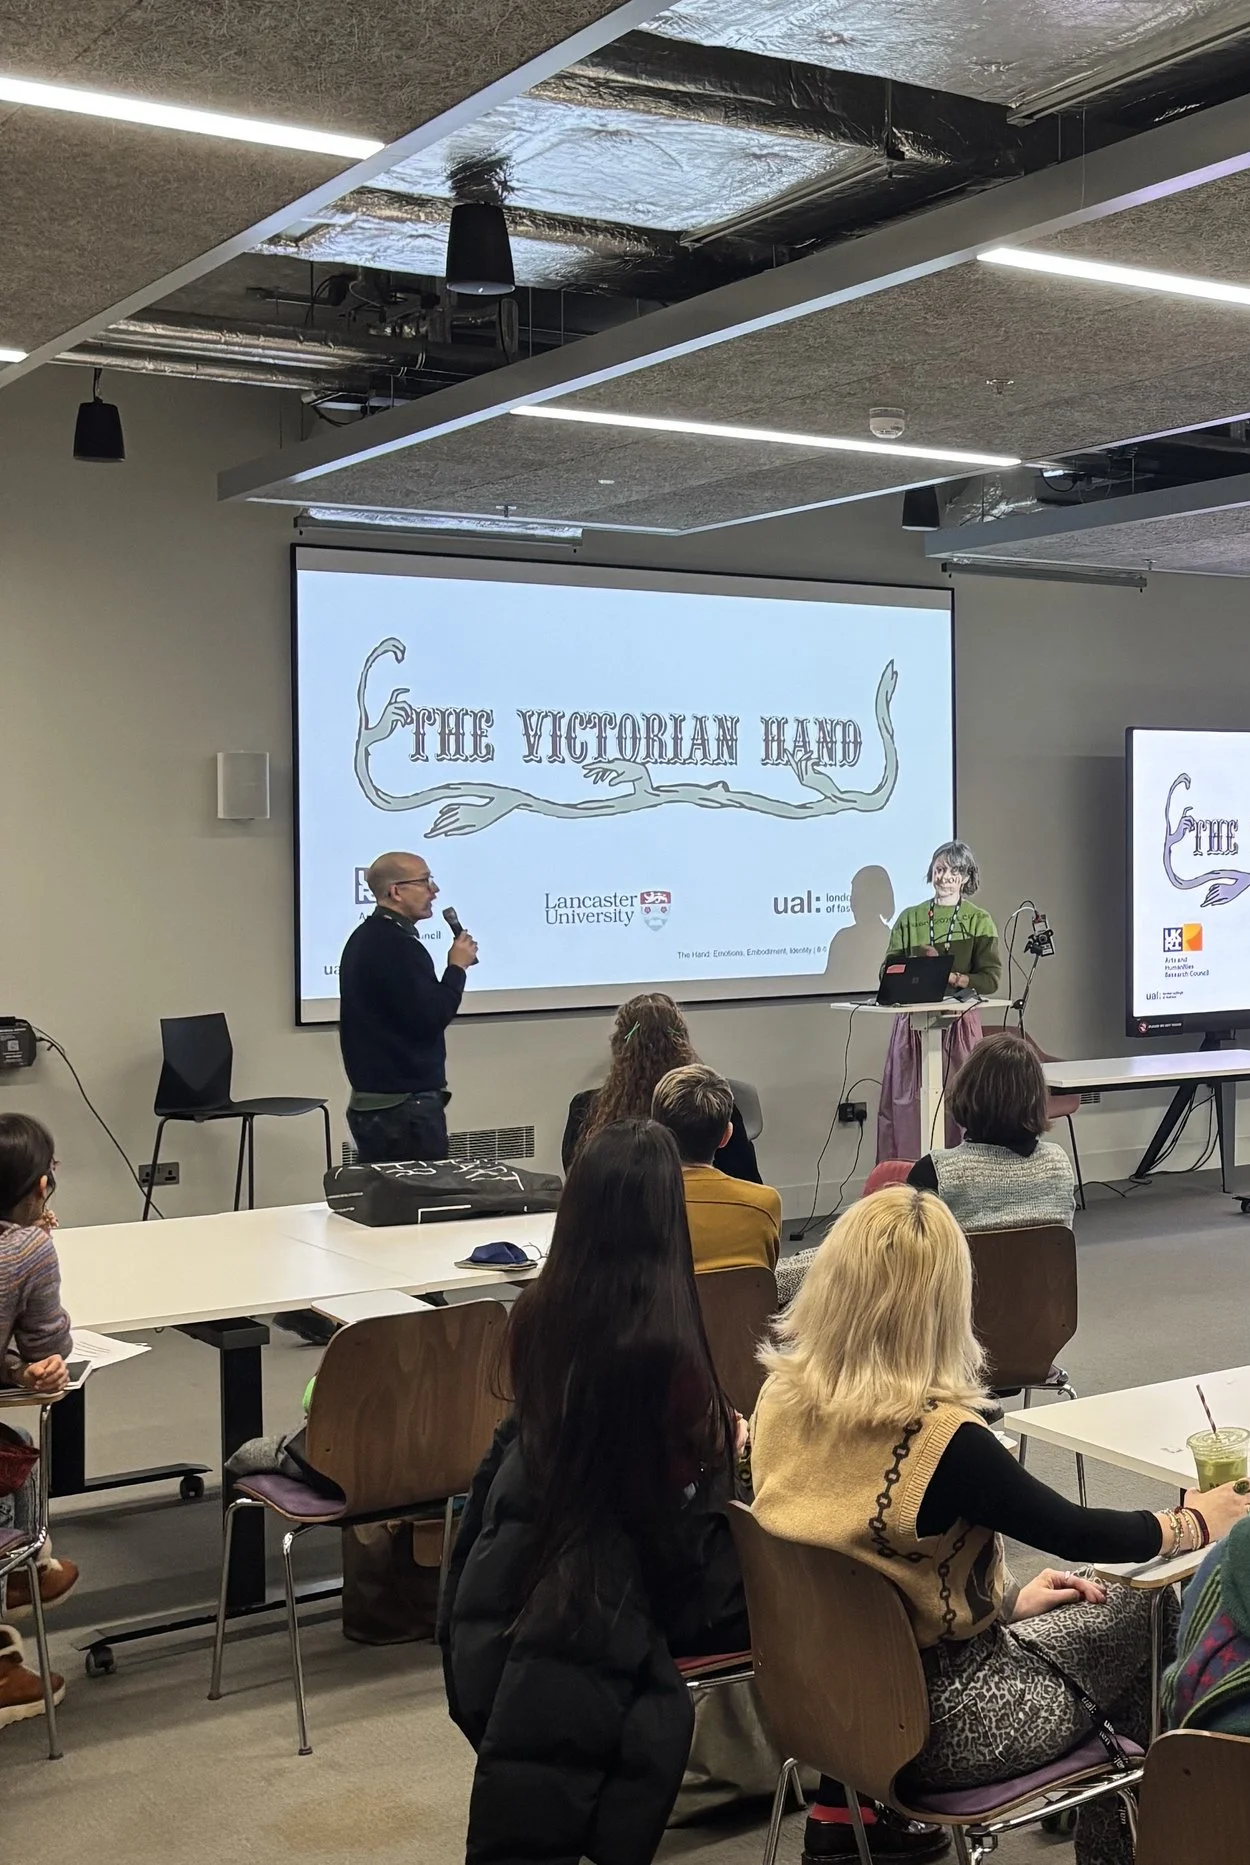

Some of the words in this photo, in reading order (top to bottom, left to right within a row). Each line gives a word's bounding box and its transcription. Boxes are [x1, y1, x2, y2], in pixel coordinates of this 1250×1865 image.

[409, 707, 494, 762] THE
[516, 708, 740, 766] VICTORIAN
[760, 714, 862, 767] HAND
[1192, 818, 1239, 856] THE
[544, 892, 638, 909] Lancaster
[773, 890, 821, 914] ual:
[826, 904, 835, 913] of
[545, 908, 634, 927] University
[1164, 928, 1182, 940] UK
